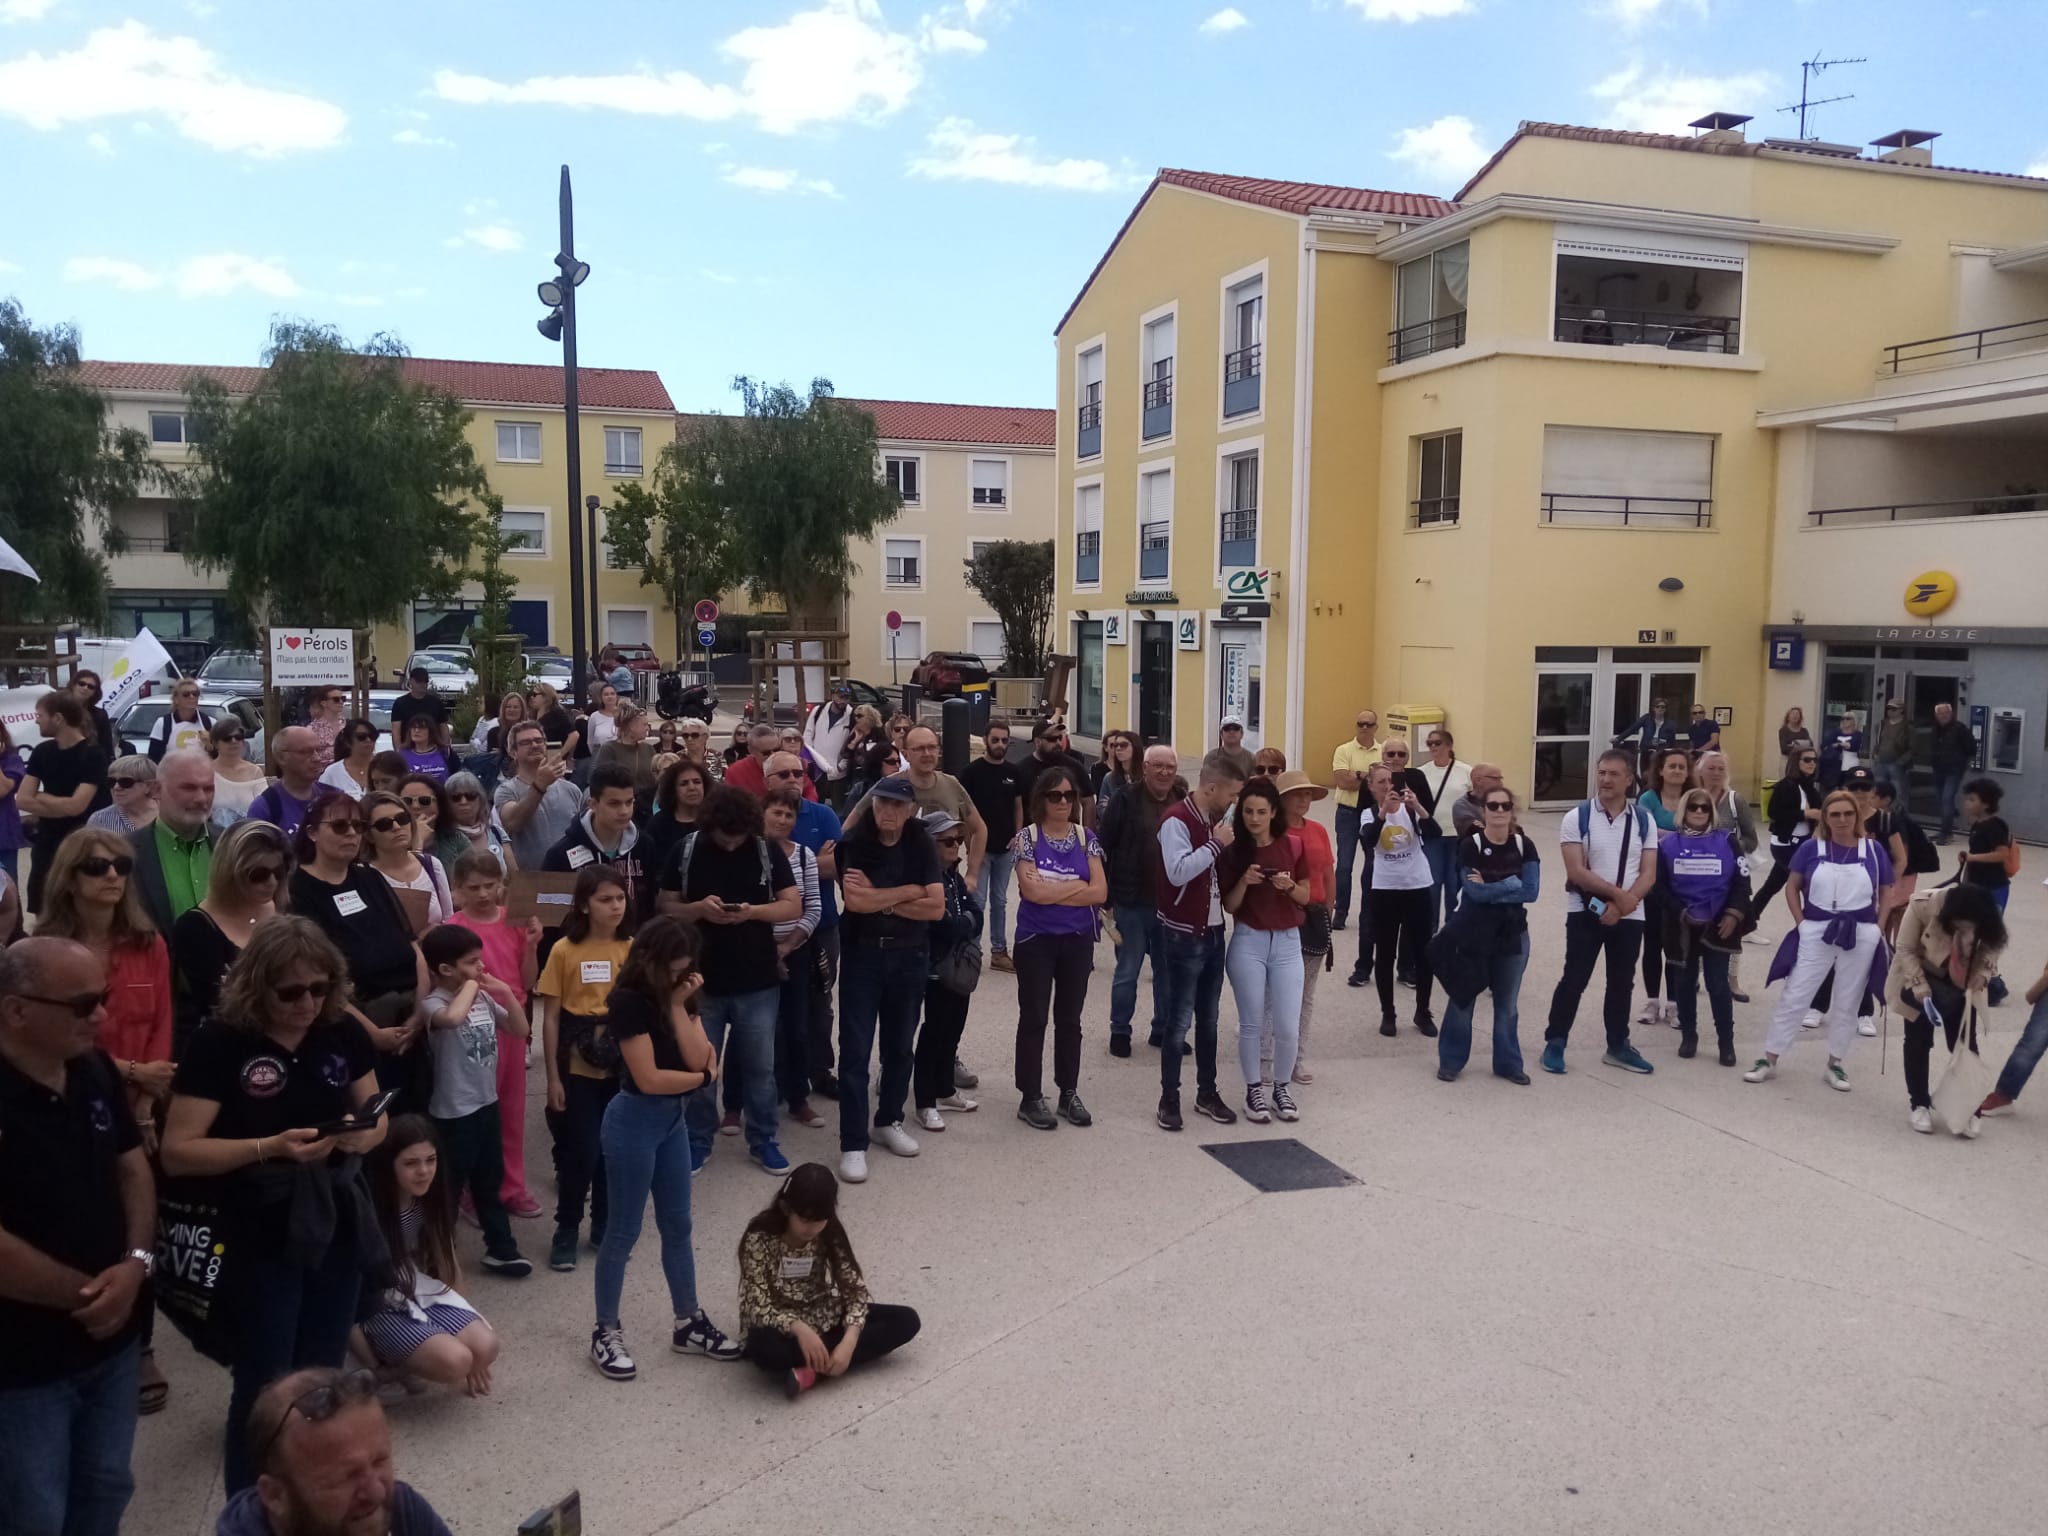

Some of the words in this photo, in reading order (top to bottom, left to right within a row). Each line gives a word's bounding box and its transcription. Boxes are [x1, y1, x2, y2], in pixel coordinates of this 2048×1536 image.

[1640, 631, 1655, 642] A2
[1876, 629, 1899, 638] LA
[1911, 629, 1978, 639] POSTE
[303, 634, 348, 650] Pérols
[276, 655, 294, 664] Mais
[294, 656, 307, 665] pas
[307, 655, 318, 664] les
[319, 655, 345, 664] corridas
